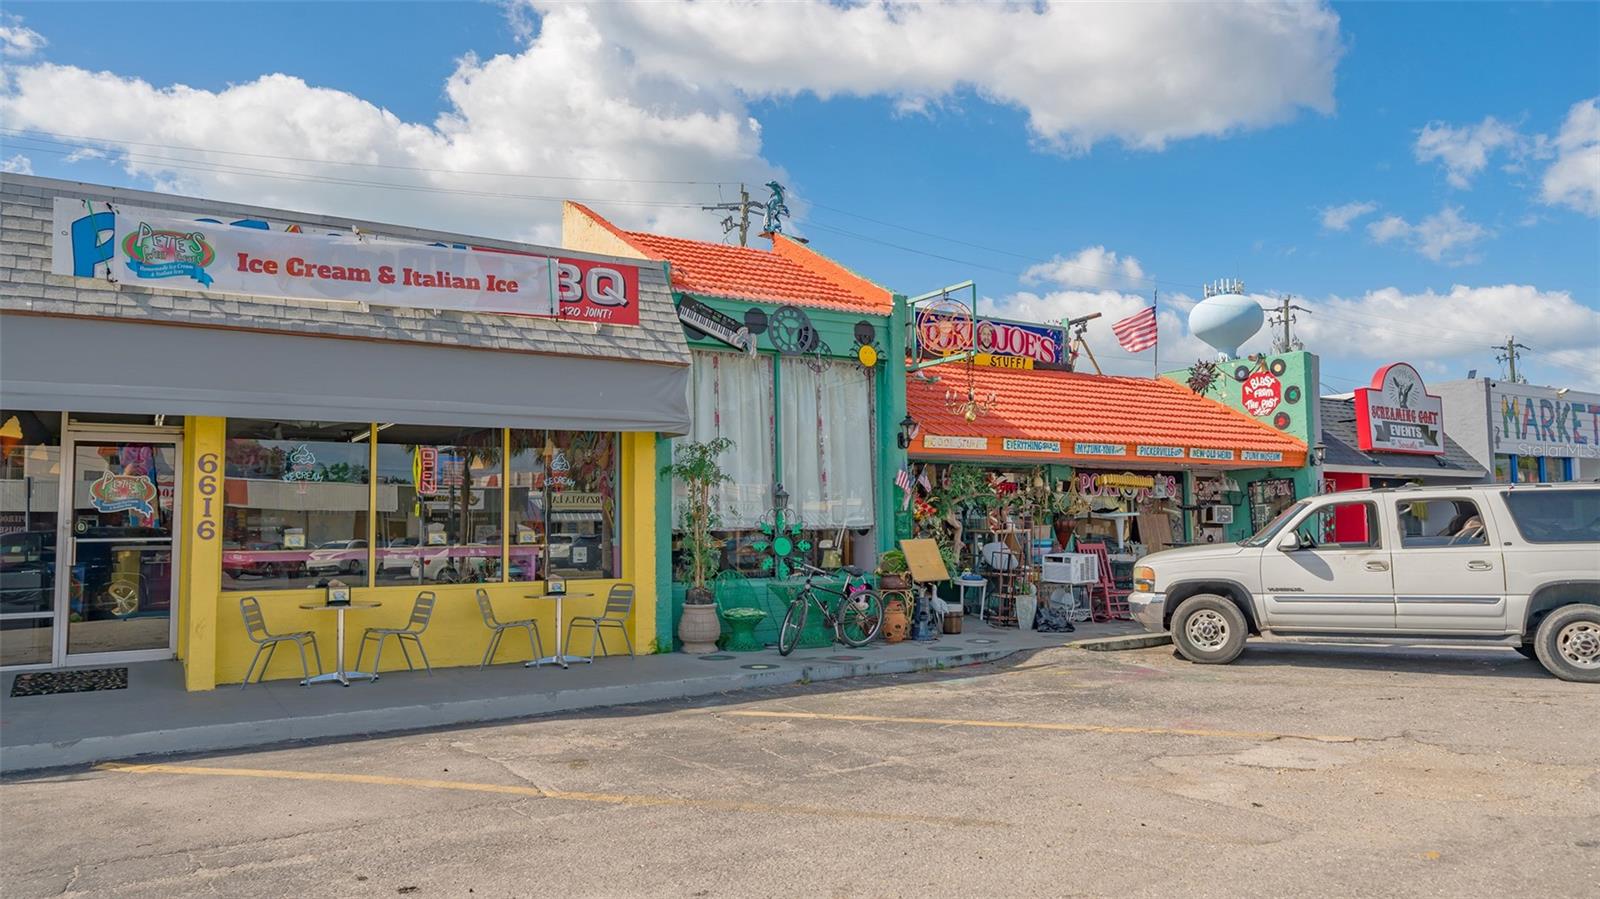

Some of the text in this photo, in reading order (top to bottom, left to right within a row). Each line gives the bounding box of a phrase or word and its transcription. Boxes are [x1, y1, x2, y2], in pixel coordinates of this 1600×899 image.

[237, 253, 519, 294] Ice Cream & Italian Ice
[584, 307, 612, 318] JOINT!
[996, 324, 1056, 364] JOE'S
[990, 356, 1027, 368] STUFF!
[1371, 405, 1438, 425] SCREAMING GOAT
[1502, 394, 1600, 446] MARKET
[1390, 424, 1422, 438] EVENTS
[296, 471, 324, 482] CREAM
